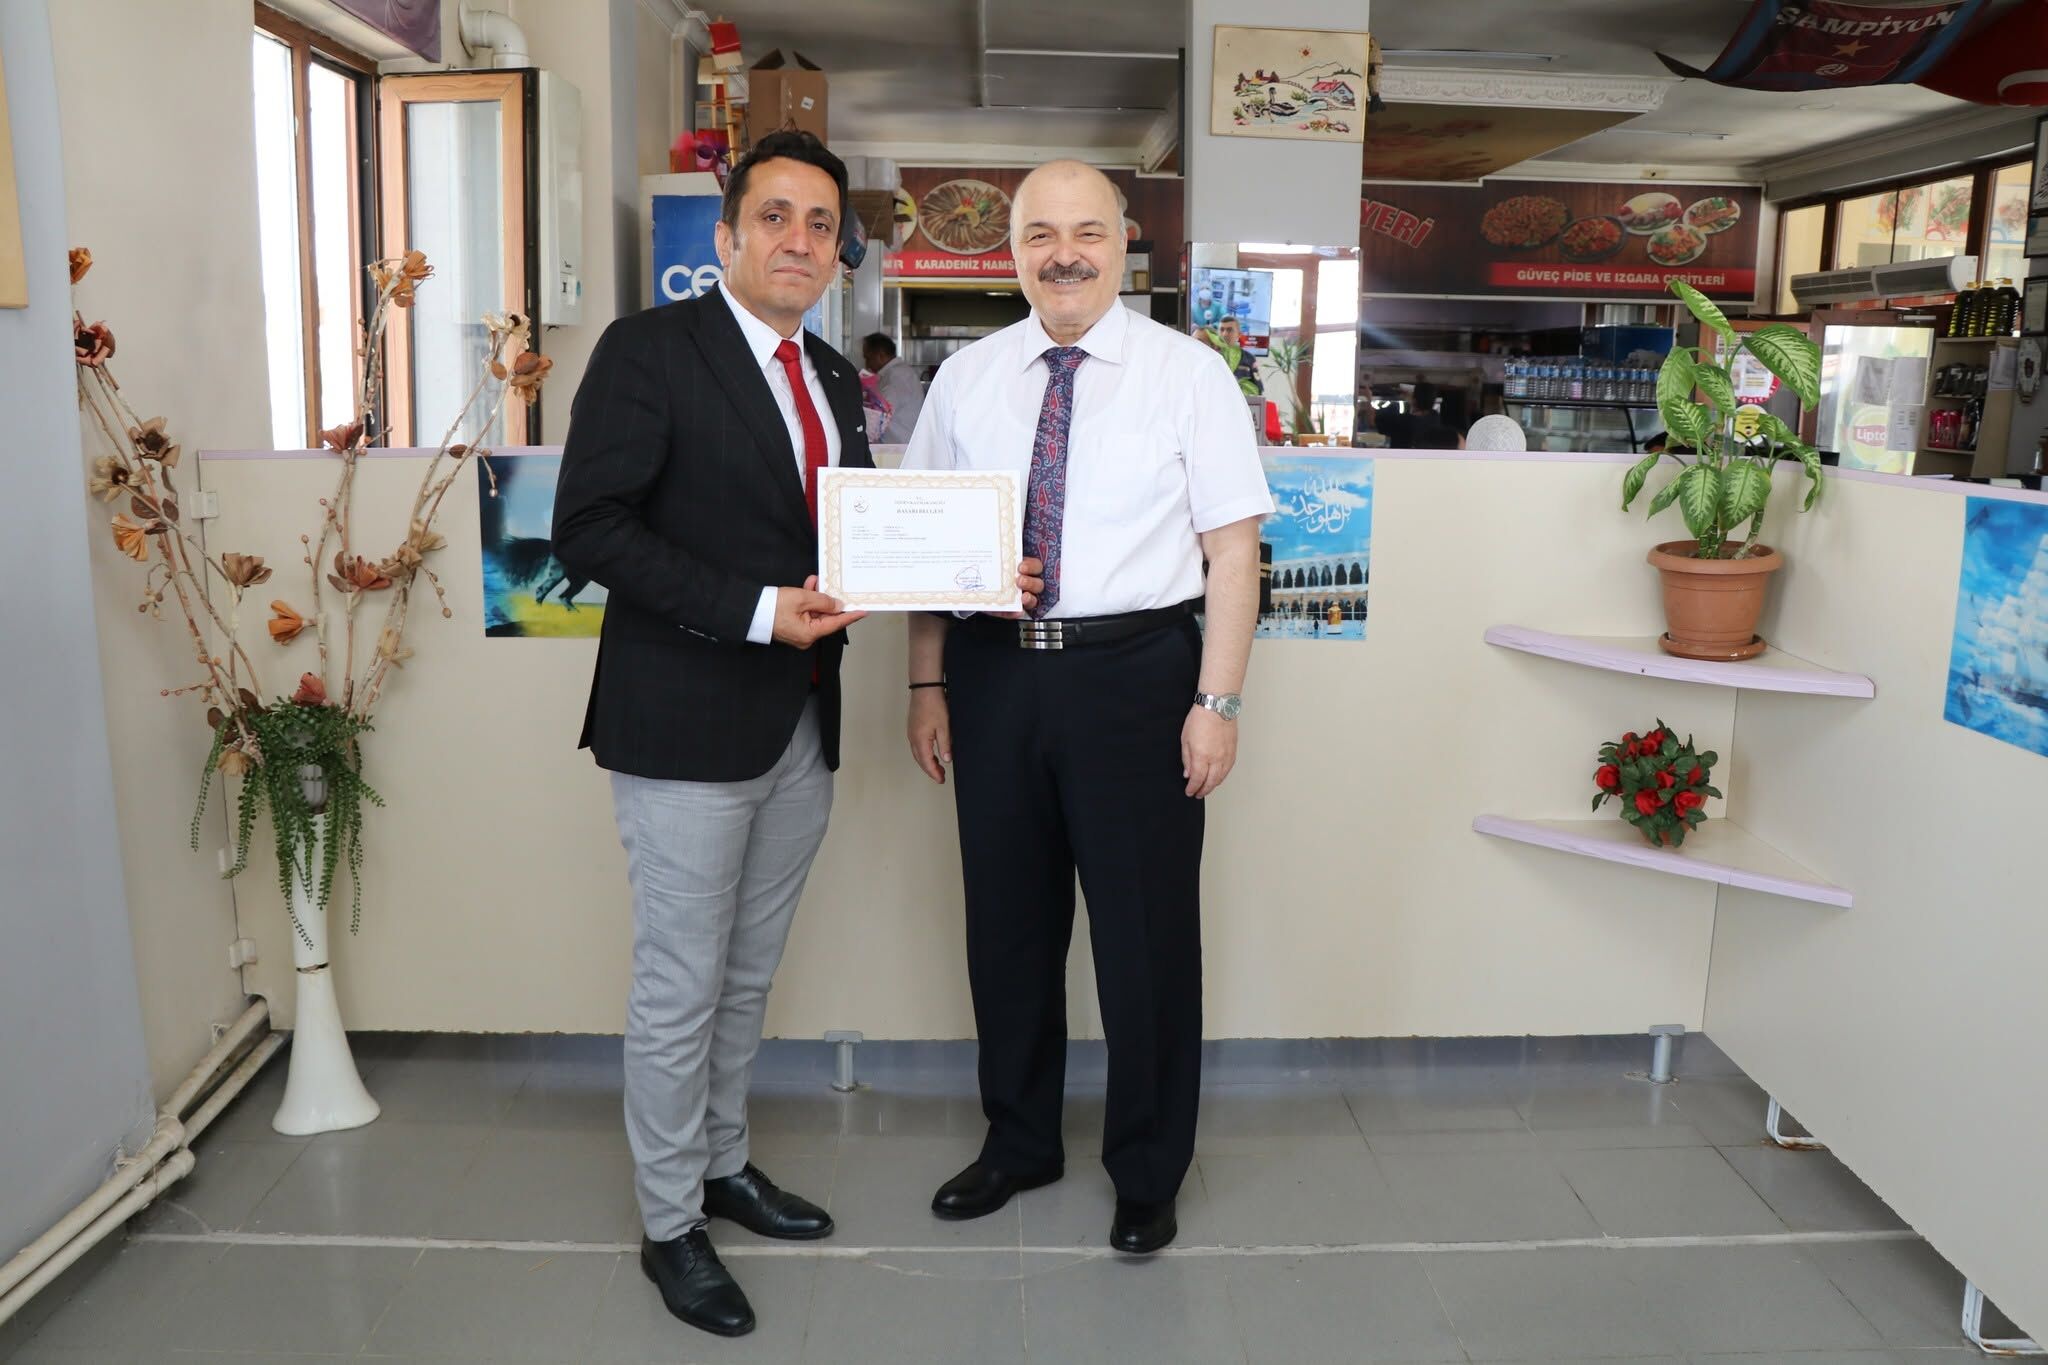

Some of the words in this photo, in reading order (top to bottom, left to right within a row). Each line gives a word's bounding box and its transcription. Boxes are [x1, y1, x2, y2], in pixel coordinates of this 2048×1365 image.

[1360, 198, 1435, 249] YERİ
[915, 257, 979, 270] KARADENİZ
[982, 259, 1015, 271] HAMS
[661, 264, 724, 301] ce
[1517, 268, 1560, 284] GÜVEÇ
[1563, 268, 1592, 282] PİDE
[1595, 272, 1612, 282] VE
[1614, 272, 1660, 284] IZGARA
[1856, 427, 1888, 442] Lipto
